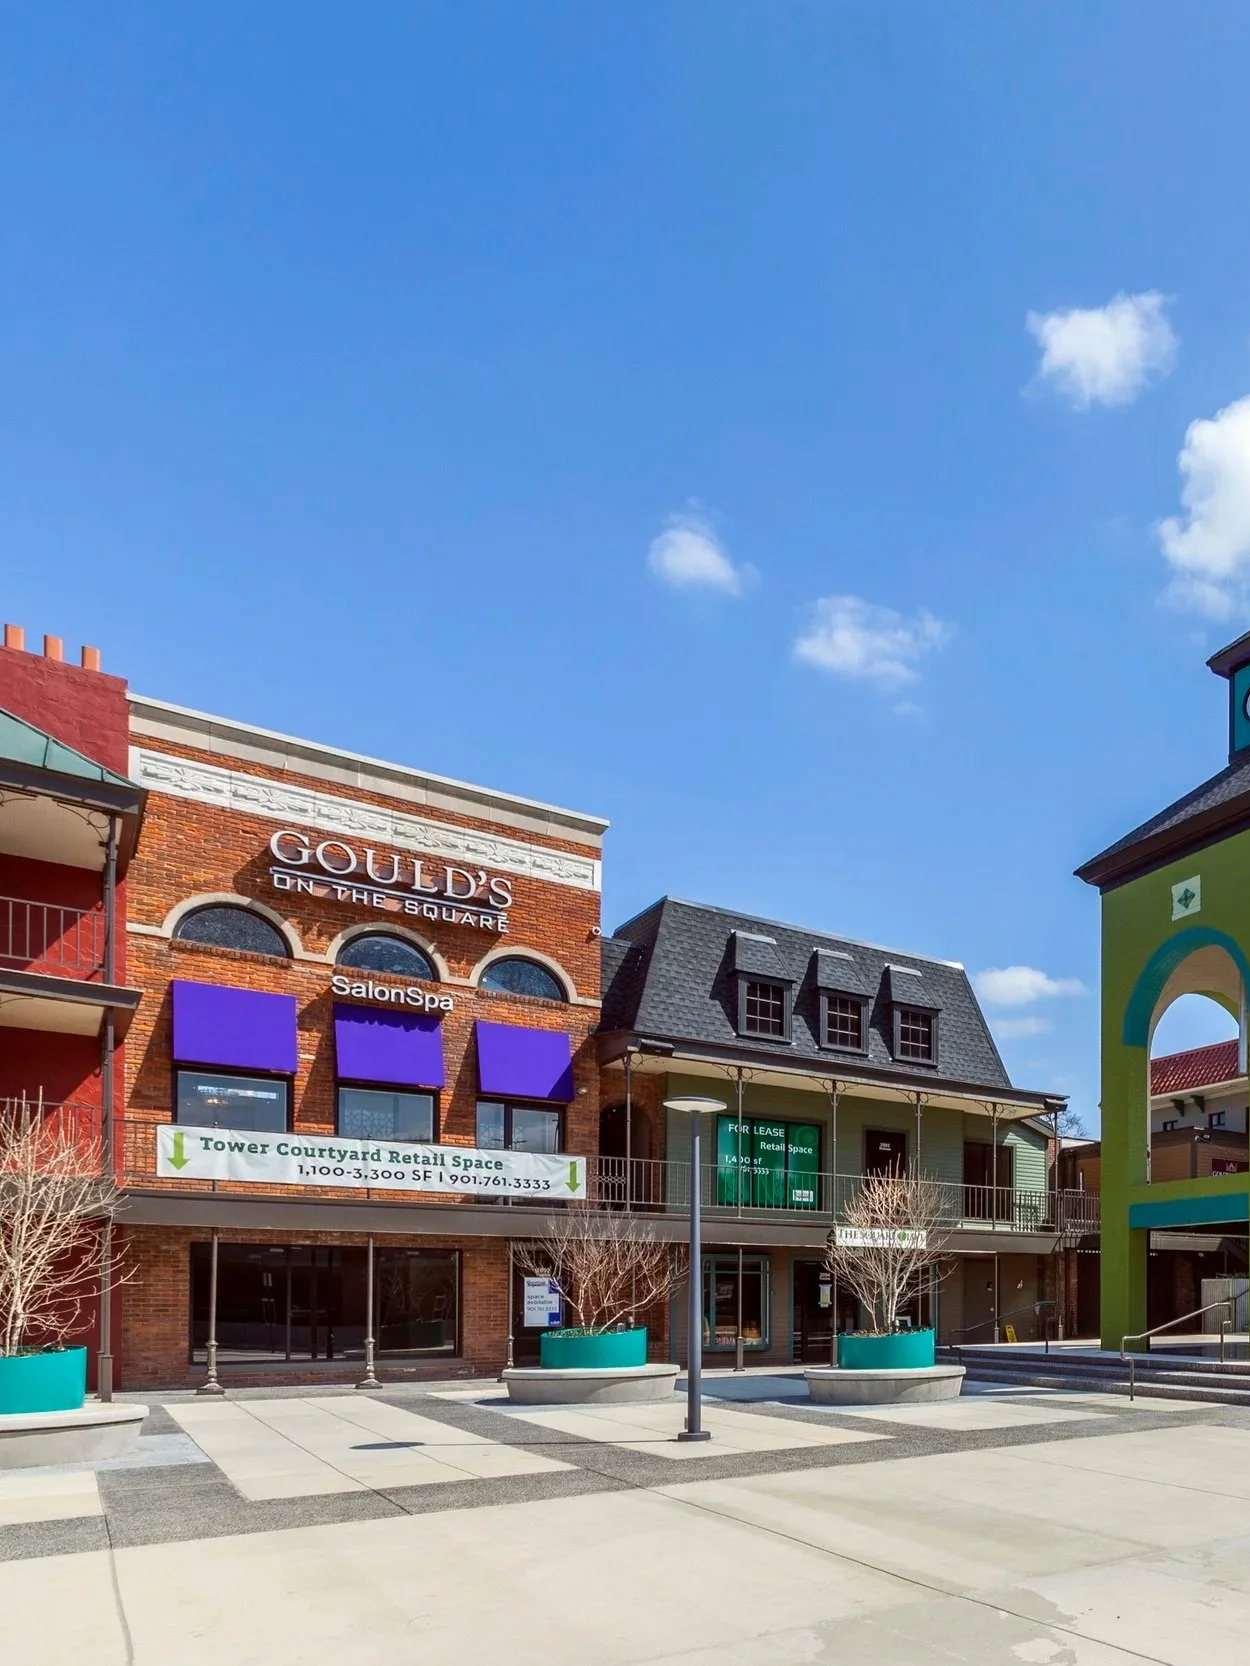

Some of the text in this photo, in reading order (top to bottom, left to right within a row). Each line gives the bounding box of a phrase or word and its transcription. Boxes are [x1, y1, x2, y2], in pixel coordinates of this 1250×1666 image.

[270, 830, 513, 908] GOULD'S
[273, 874, 510, 934] ON THE SQUARE
[331, 975, 454, 1012] SalonSpa
[728, 1123, 785, 1138] FOR LEASE
[760, 1141, 813, 1155] Retail Space
[199, 1136, 504, 1172] Tower Courtyard Retail Space
[297, 1164, 406, 1181] 1,100-3,300
[411, 1169, 433, 1182] SF
[449, 1174, 551, 1190] 901.761.3333
